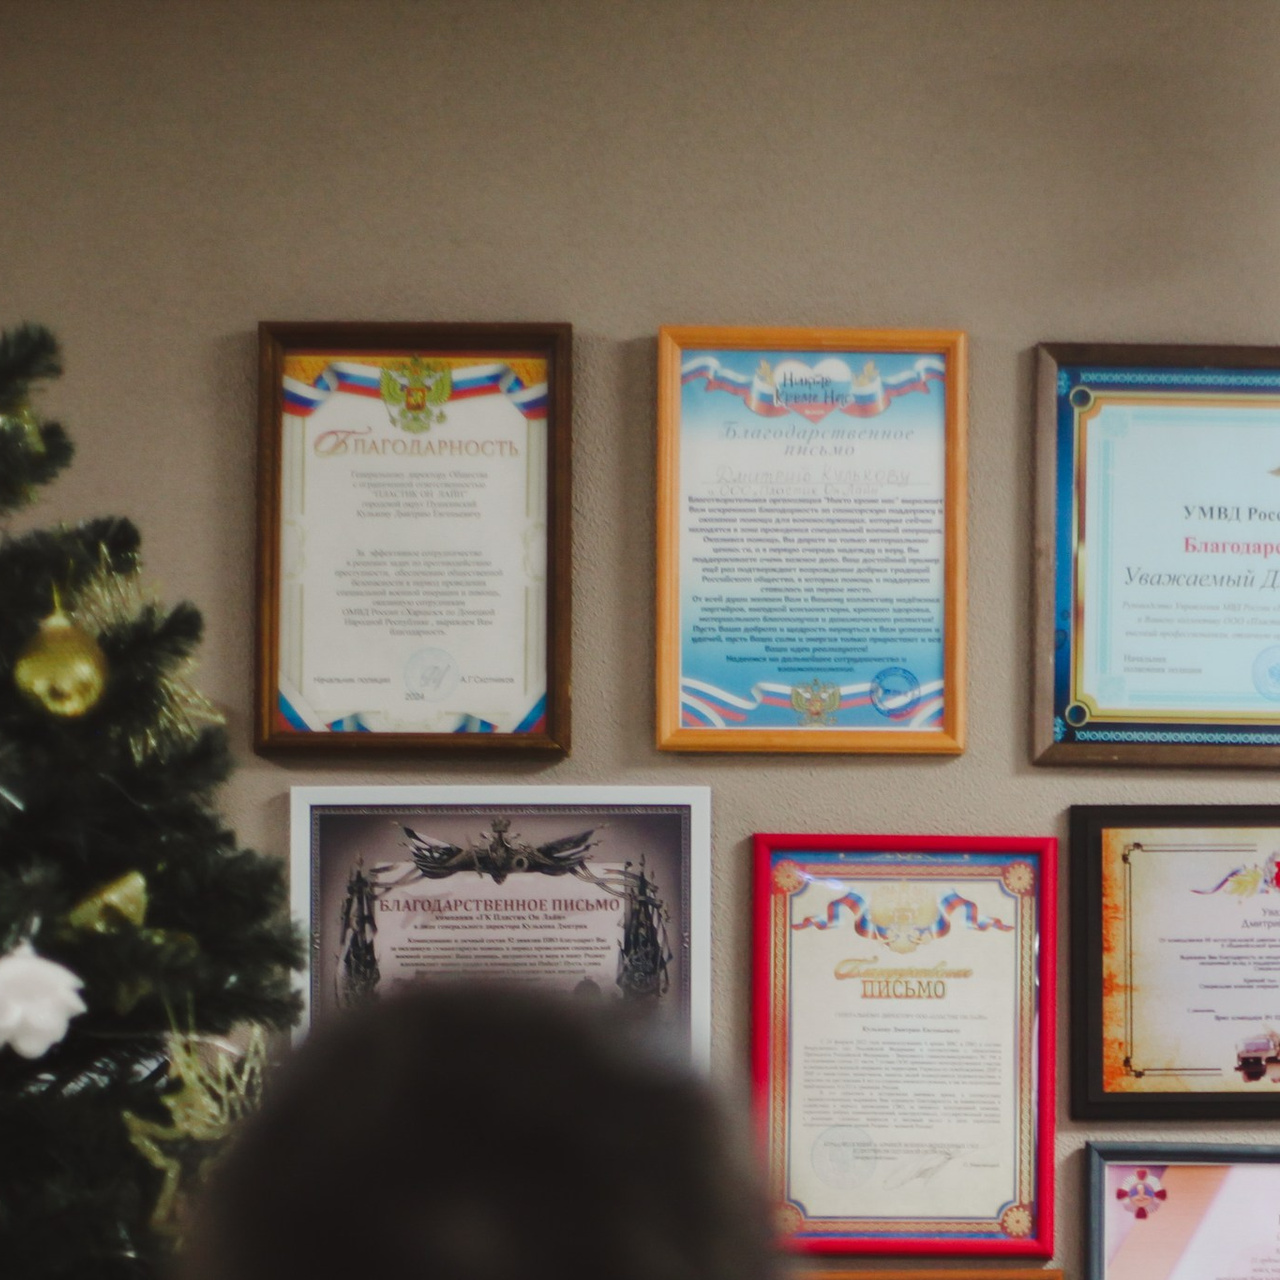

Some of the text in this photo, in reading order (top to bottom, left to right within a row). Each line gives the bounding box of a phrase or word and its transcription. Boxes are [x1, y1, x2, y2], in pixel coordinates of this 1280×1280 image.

[313, 426, 519, 458] БЛАГОДАРНОСТЬ
[722, 420, 915, 444] Благодарственное
[783, 445, 856, 457] письмо
[1183, 505, 1242, 523] УМВД
[1124, 566, 1255, 589] Уважаемый
[379, 899, 620, 912] БЛАГОДАРСТВЕННОЕ ПИСЬМО
[861, 979, 946, 999] ПИСЬМО
